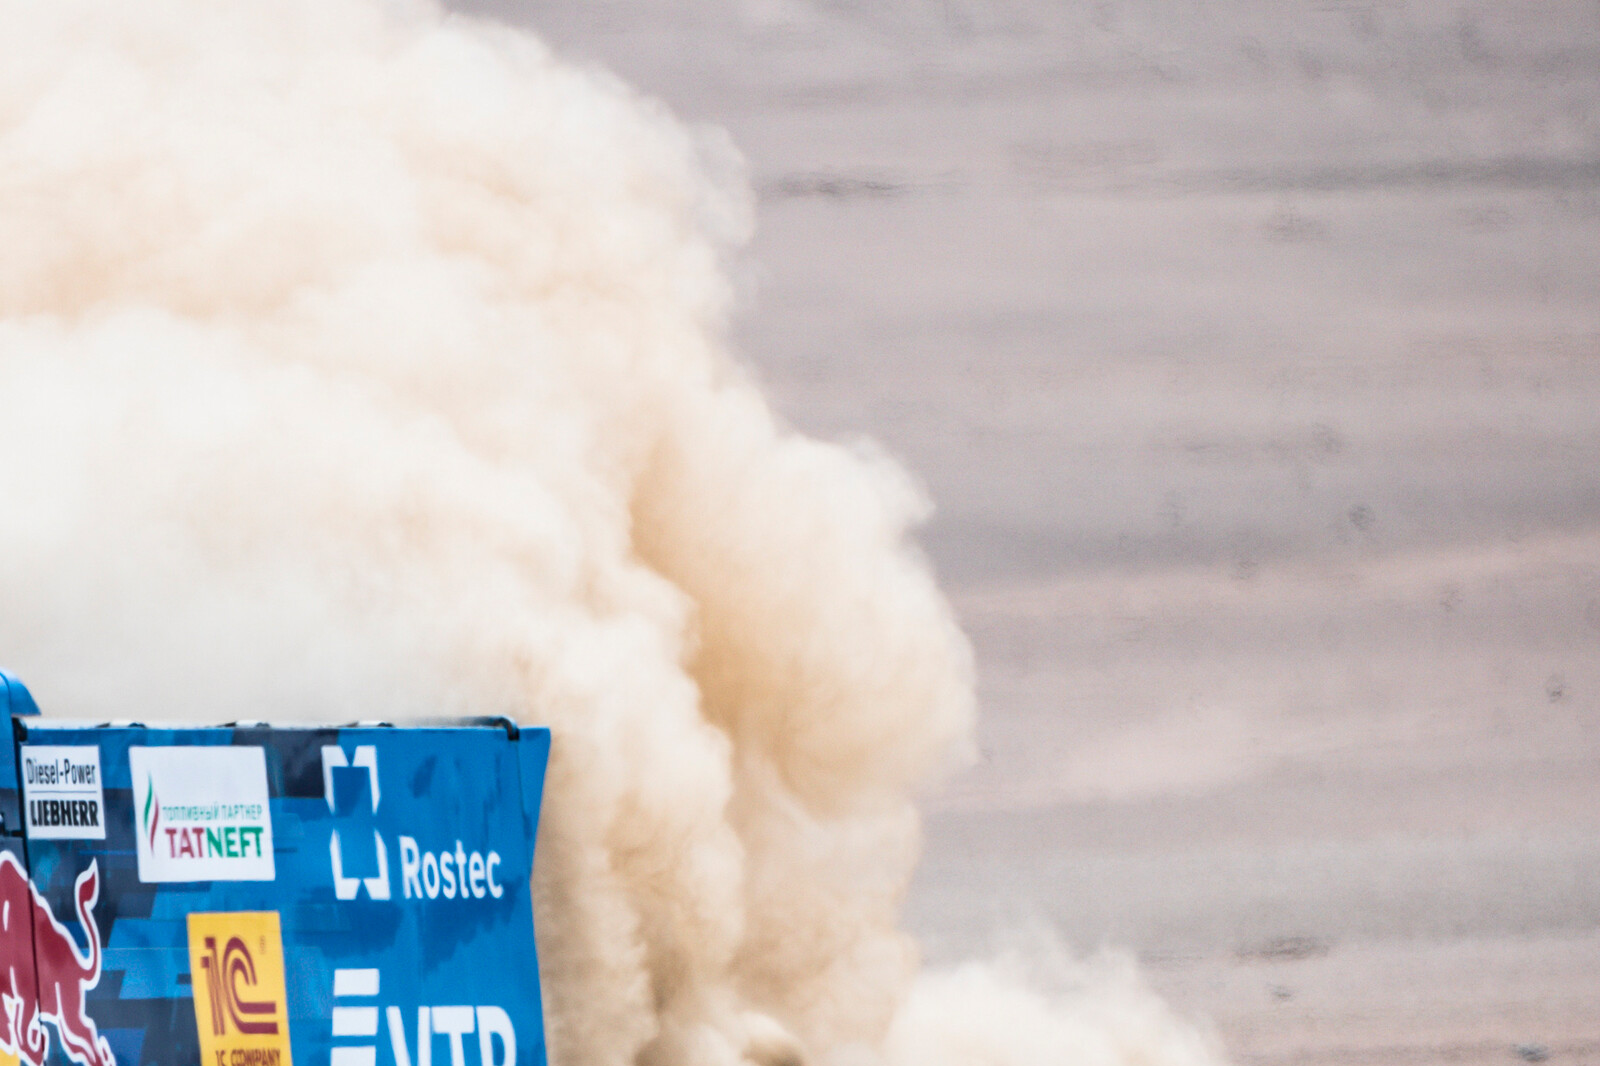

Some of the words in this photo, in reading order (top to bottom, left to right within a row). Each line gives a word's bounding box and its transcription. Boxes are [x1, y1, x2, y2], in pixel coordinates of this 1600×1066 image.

[26, 758, 96, 785] Diesel-Power
[30, 800, 99, 827] LIEBHERR
[165, 826, 264, 859] TATNEFT
[399, 835, 504, 899] Rostec
